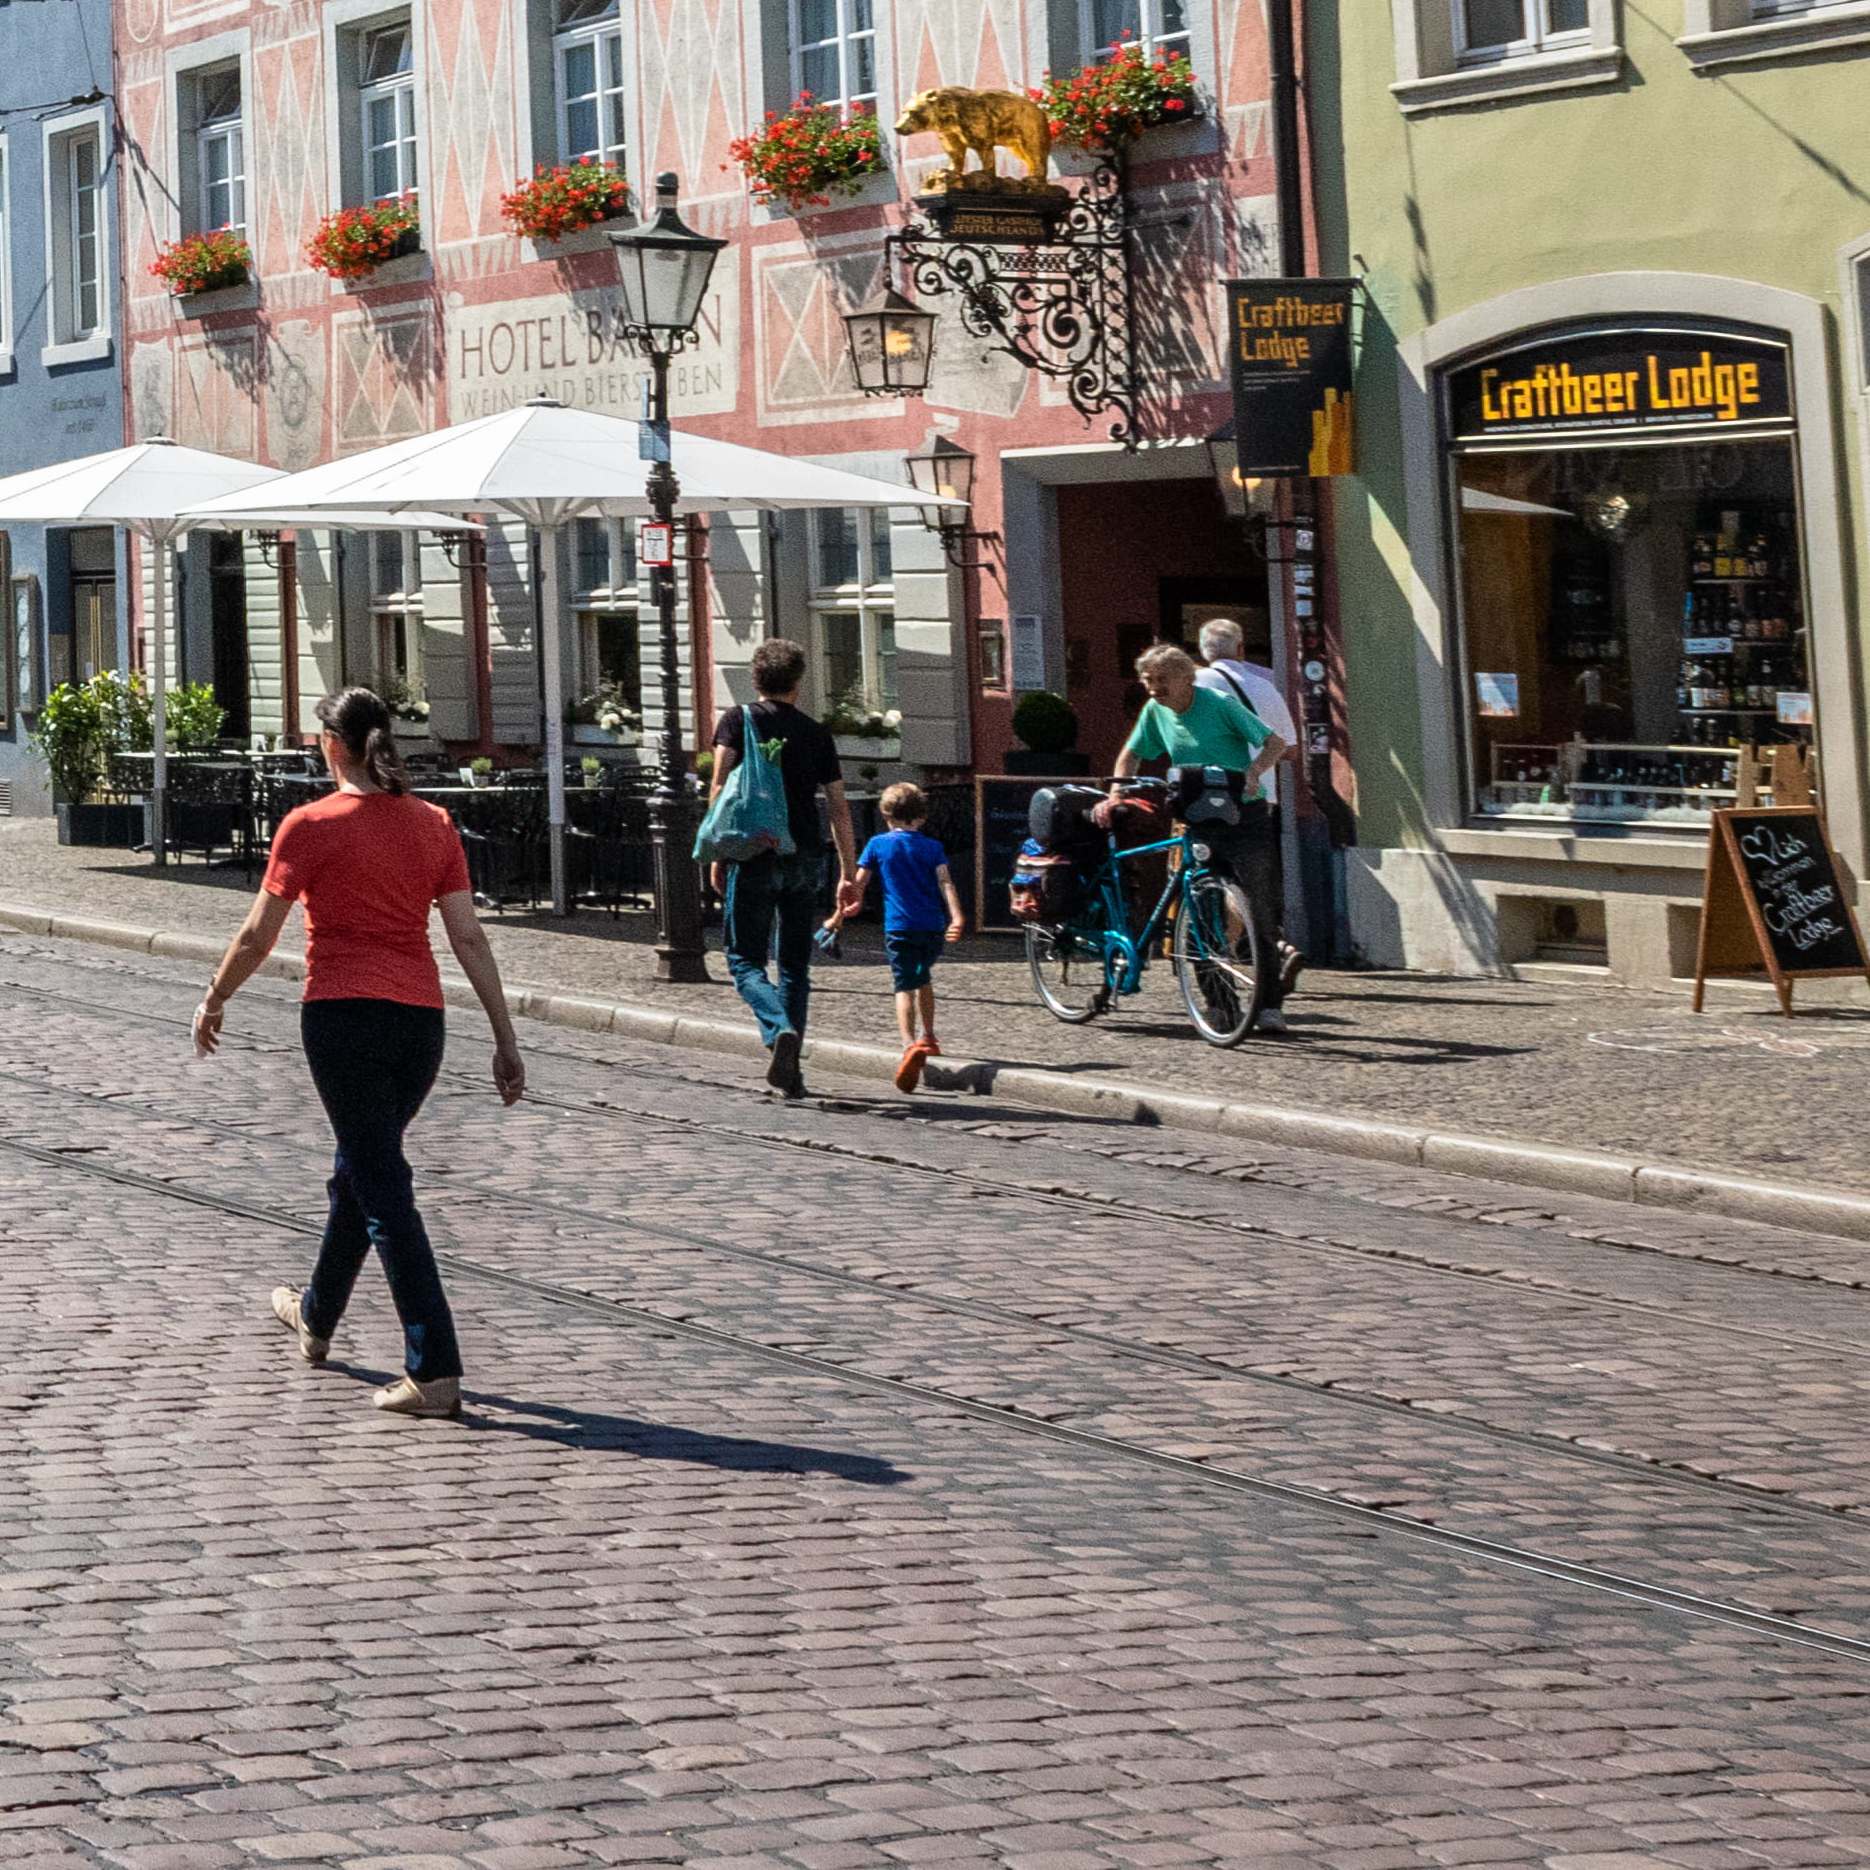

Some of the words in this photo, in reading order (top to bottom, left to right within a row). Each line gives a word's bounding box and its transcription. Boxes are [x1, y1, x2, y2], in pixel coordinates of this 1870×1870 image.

[1237, 296, 1345, 329] Craftbeer
[460, 313, 577, 380] HOTEL
[1239, 329, 1311, 368] Lodge
[585, 362, 723, 406] BIERSTBEN
[1481, 361, 1640, 420] Craftbeer
[1646, 350, 1761, 420] Lodge
